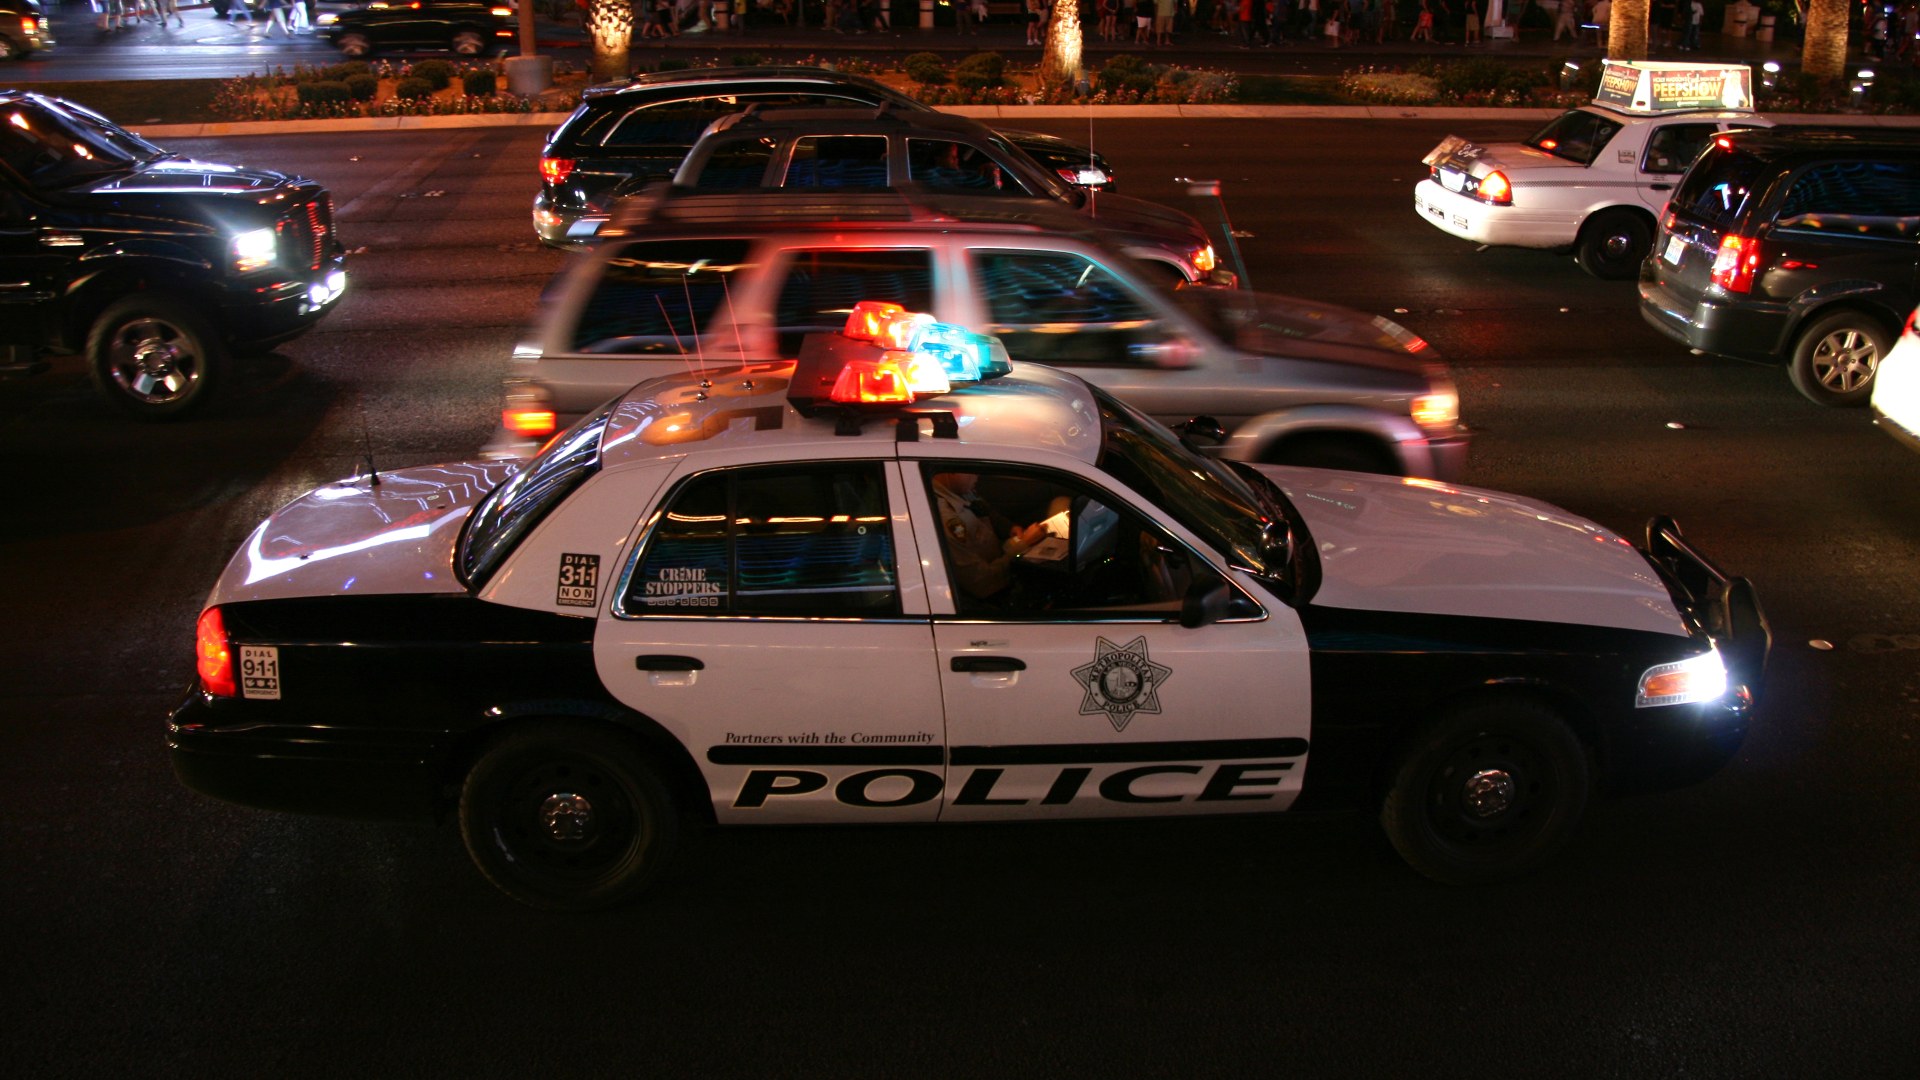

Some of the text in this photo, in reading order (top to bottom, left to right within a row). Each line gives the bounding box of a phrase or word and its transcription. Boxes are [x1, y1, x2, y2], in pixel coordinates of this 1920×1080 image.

[1603, 75, 1637, 92] PEEPSHOW
[1653, 81, 1721, 97] PEEPSHOW
[565, 556, 595, 565] DIAL
[561, 588, 593, 598] NON
[645, 582, 720, 595] STOPPERS
[559, 599, 594, 607] EMERGENCY
[245, 650, 273, 658] DIAL
[1091, 652, 1152, 683] METROPOLITAN
[1103, 700, 1141, 712] POLICE
[725, 731, 935, 745] Partners with the Community
[732, 762, 1294, 808] POLICE
